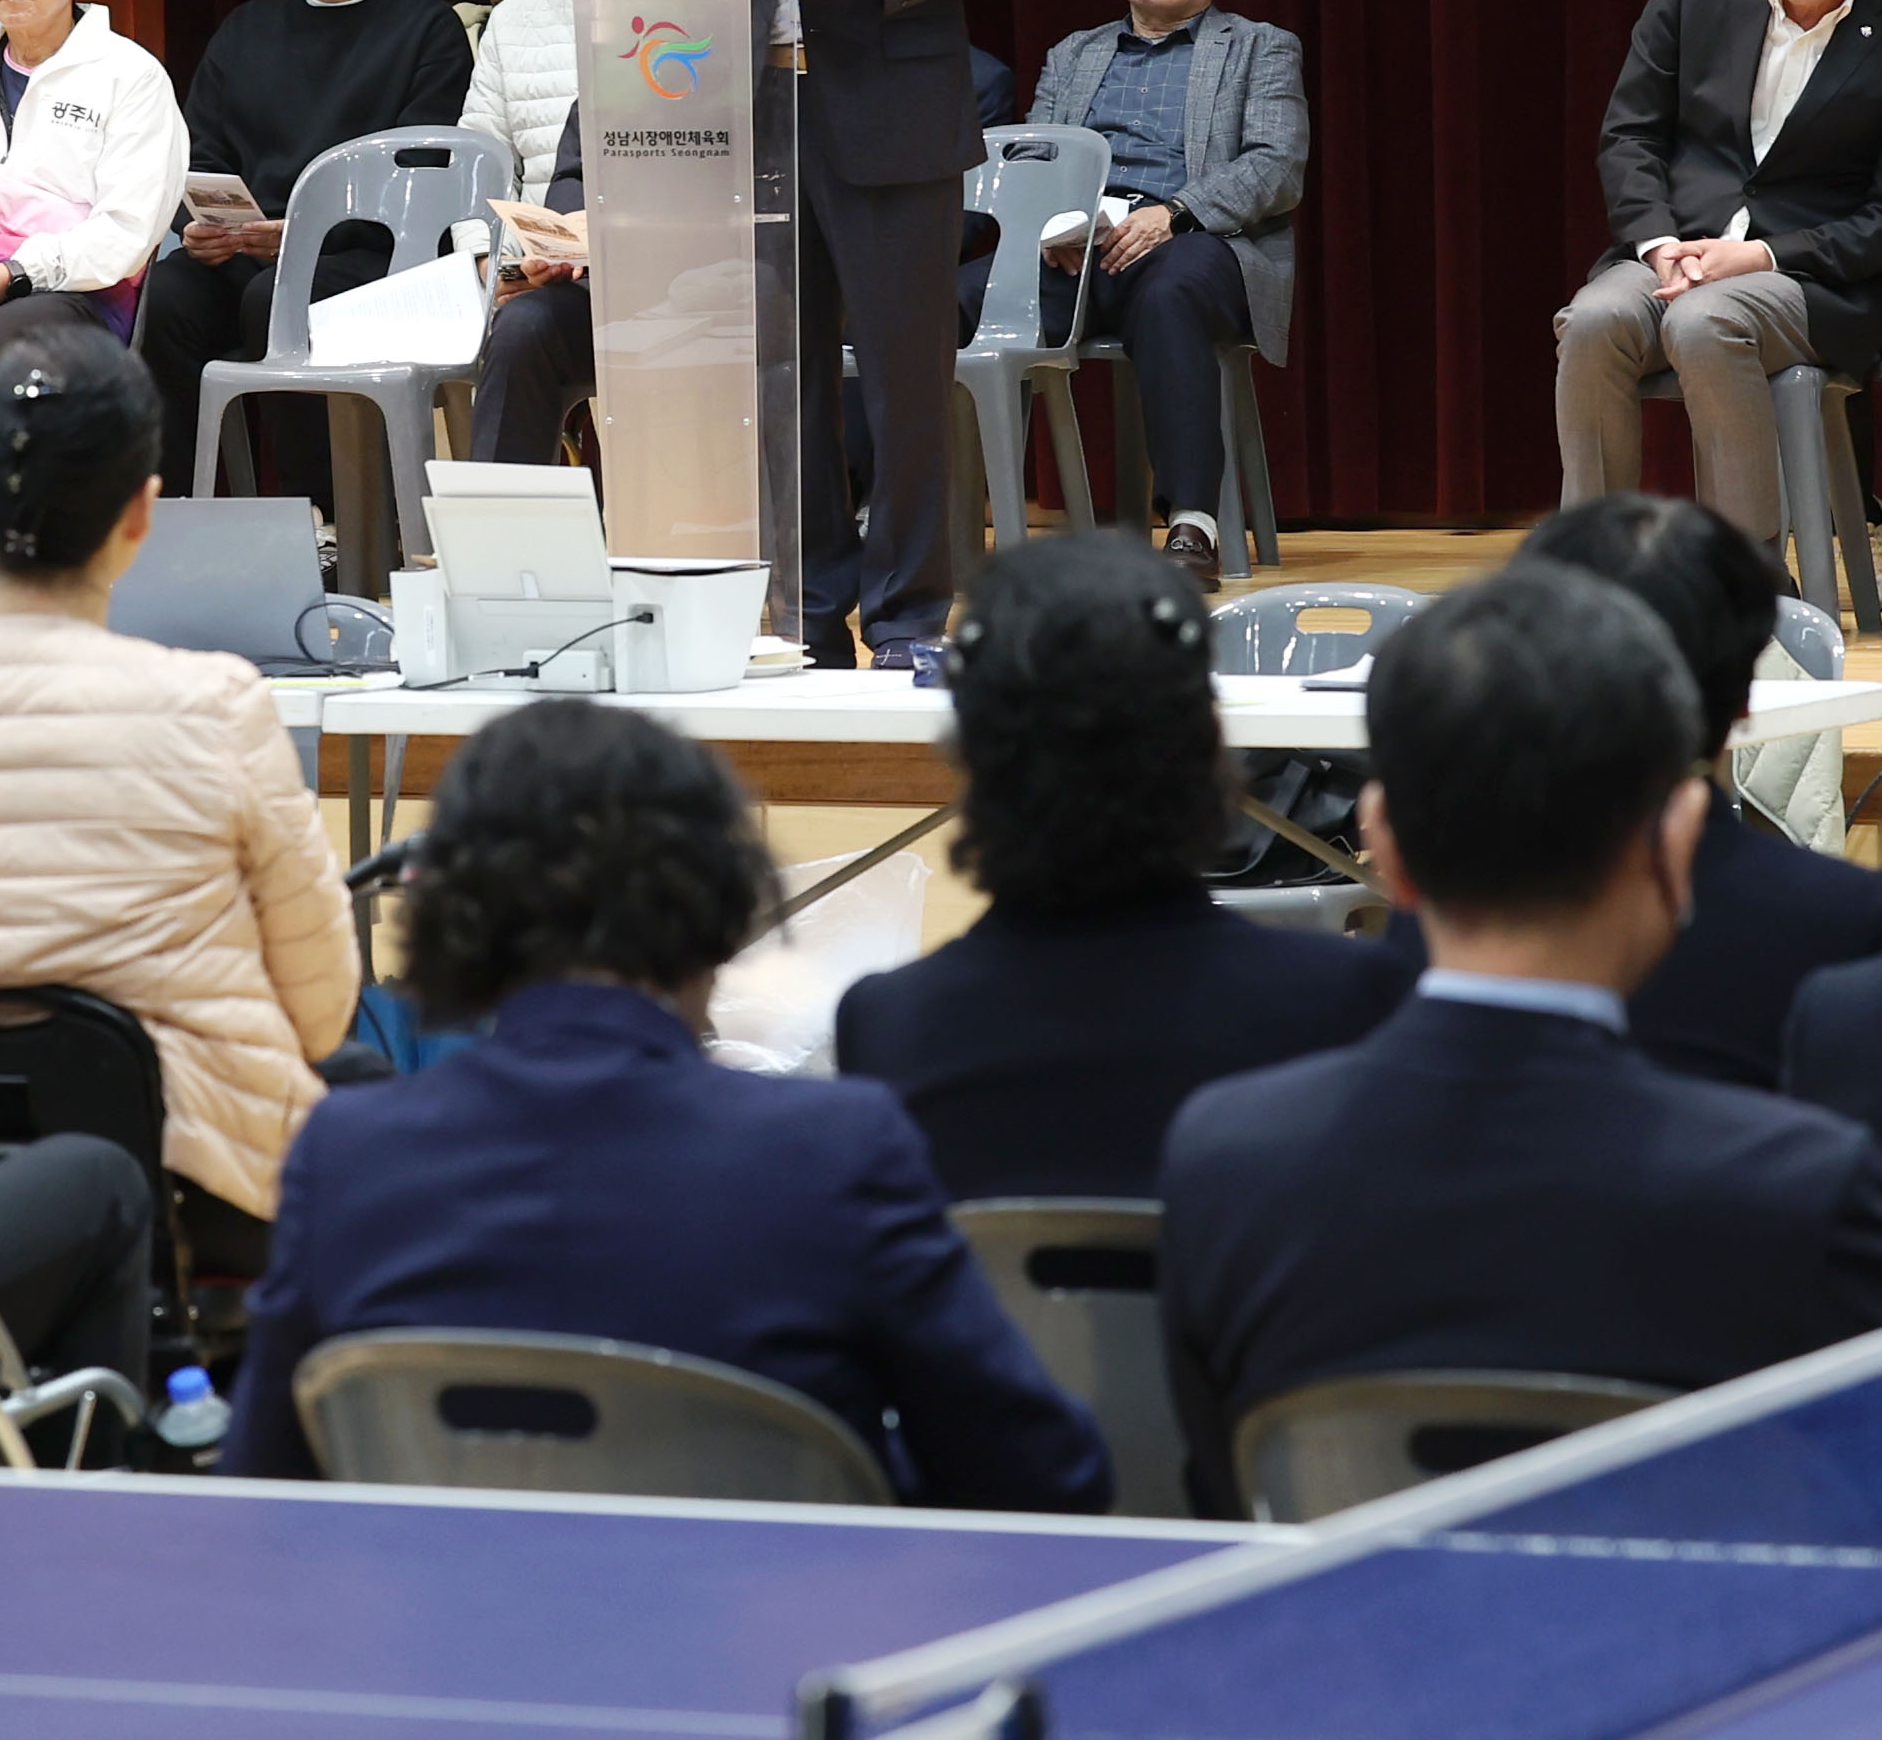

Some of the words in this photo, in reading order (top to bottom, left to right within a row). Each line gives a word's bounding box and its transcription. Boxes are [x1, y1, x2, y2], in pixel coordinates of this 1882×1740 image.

[51, 101, 101, 128] 광주시
[603, 130, 730, 147] 성남시장애인체육회
[603, 148, 667, 159] Parasports
[671, 148, 730, 160] Seongnam
